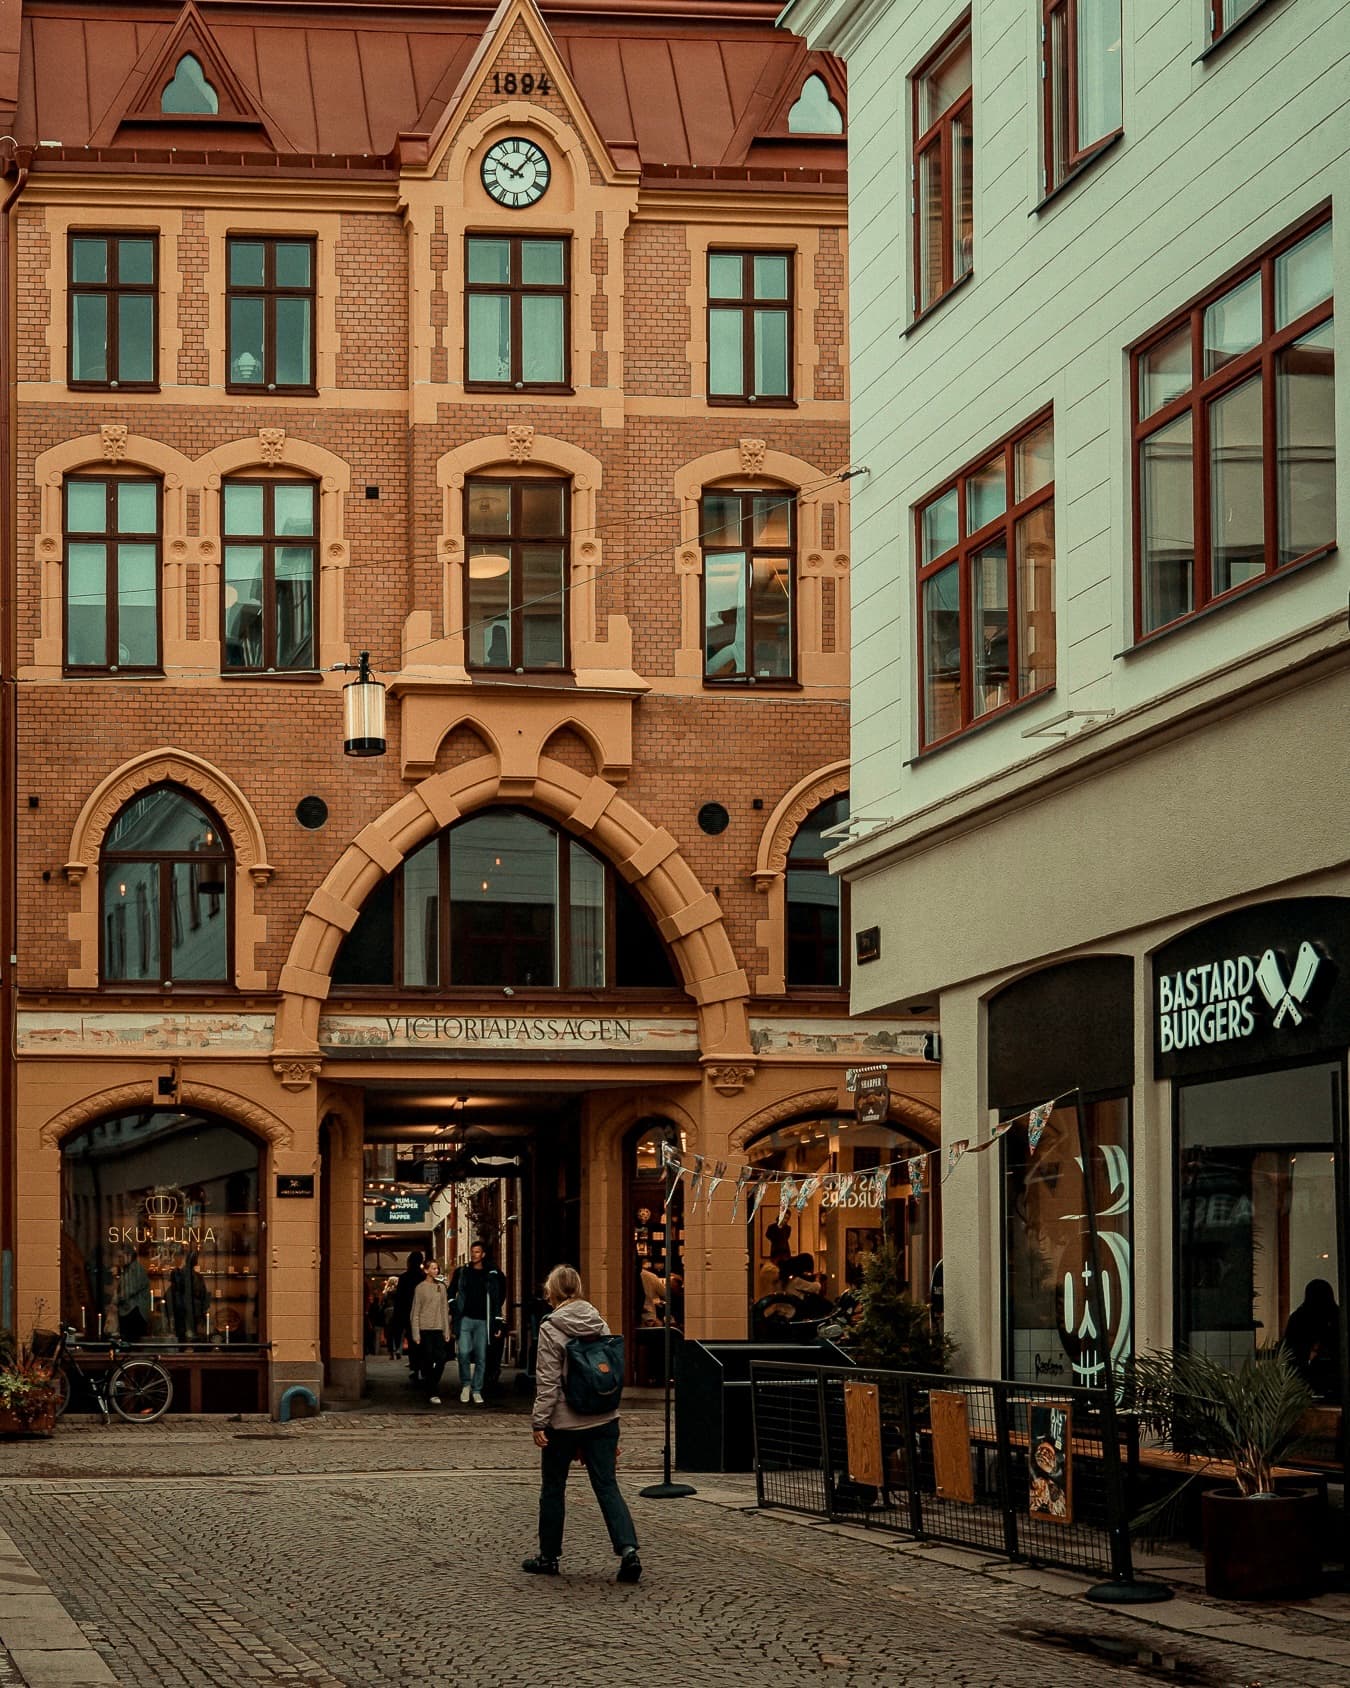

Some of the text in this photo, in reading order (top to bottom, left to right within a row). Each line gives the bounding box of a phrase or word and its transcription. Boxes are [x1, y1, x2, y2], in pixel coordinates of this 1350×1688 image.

[493, 72, 551, 95] 1894
[1160, 956, 1254, 1013] BASTARD
[385, 1017, 632, 1041] VICTORIAPASSAGEN
[1160, 995, 1255, 1053] BURGERS
[108, 1226, 216, 1243] SKULTUNA
